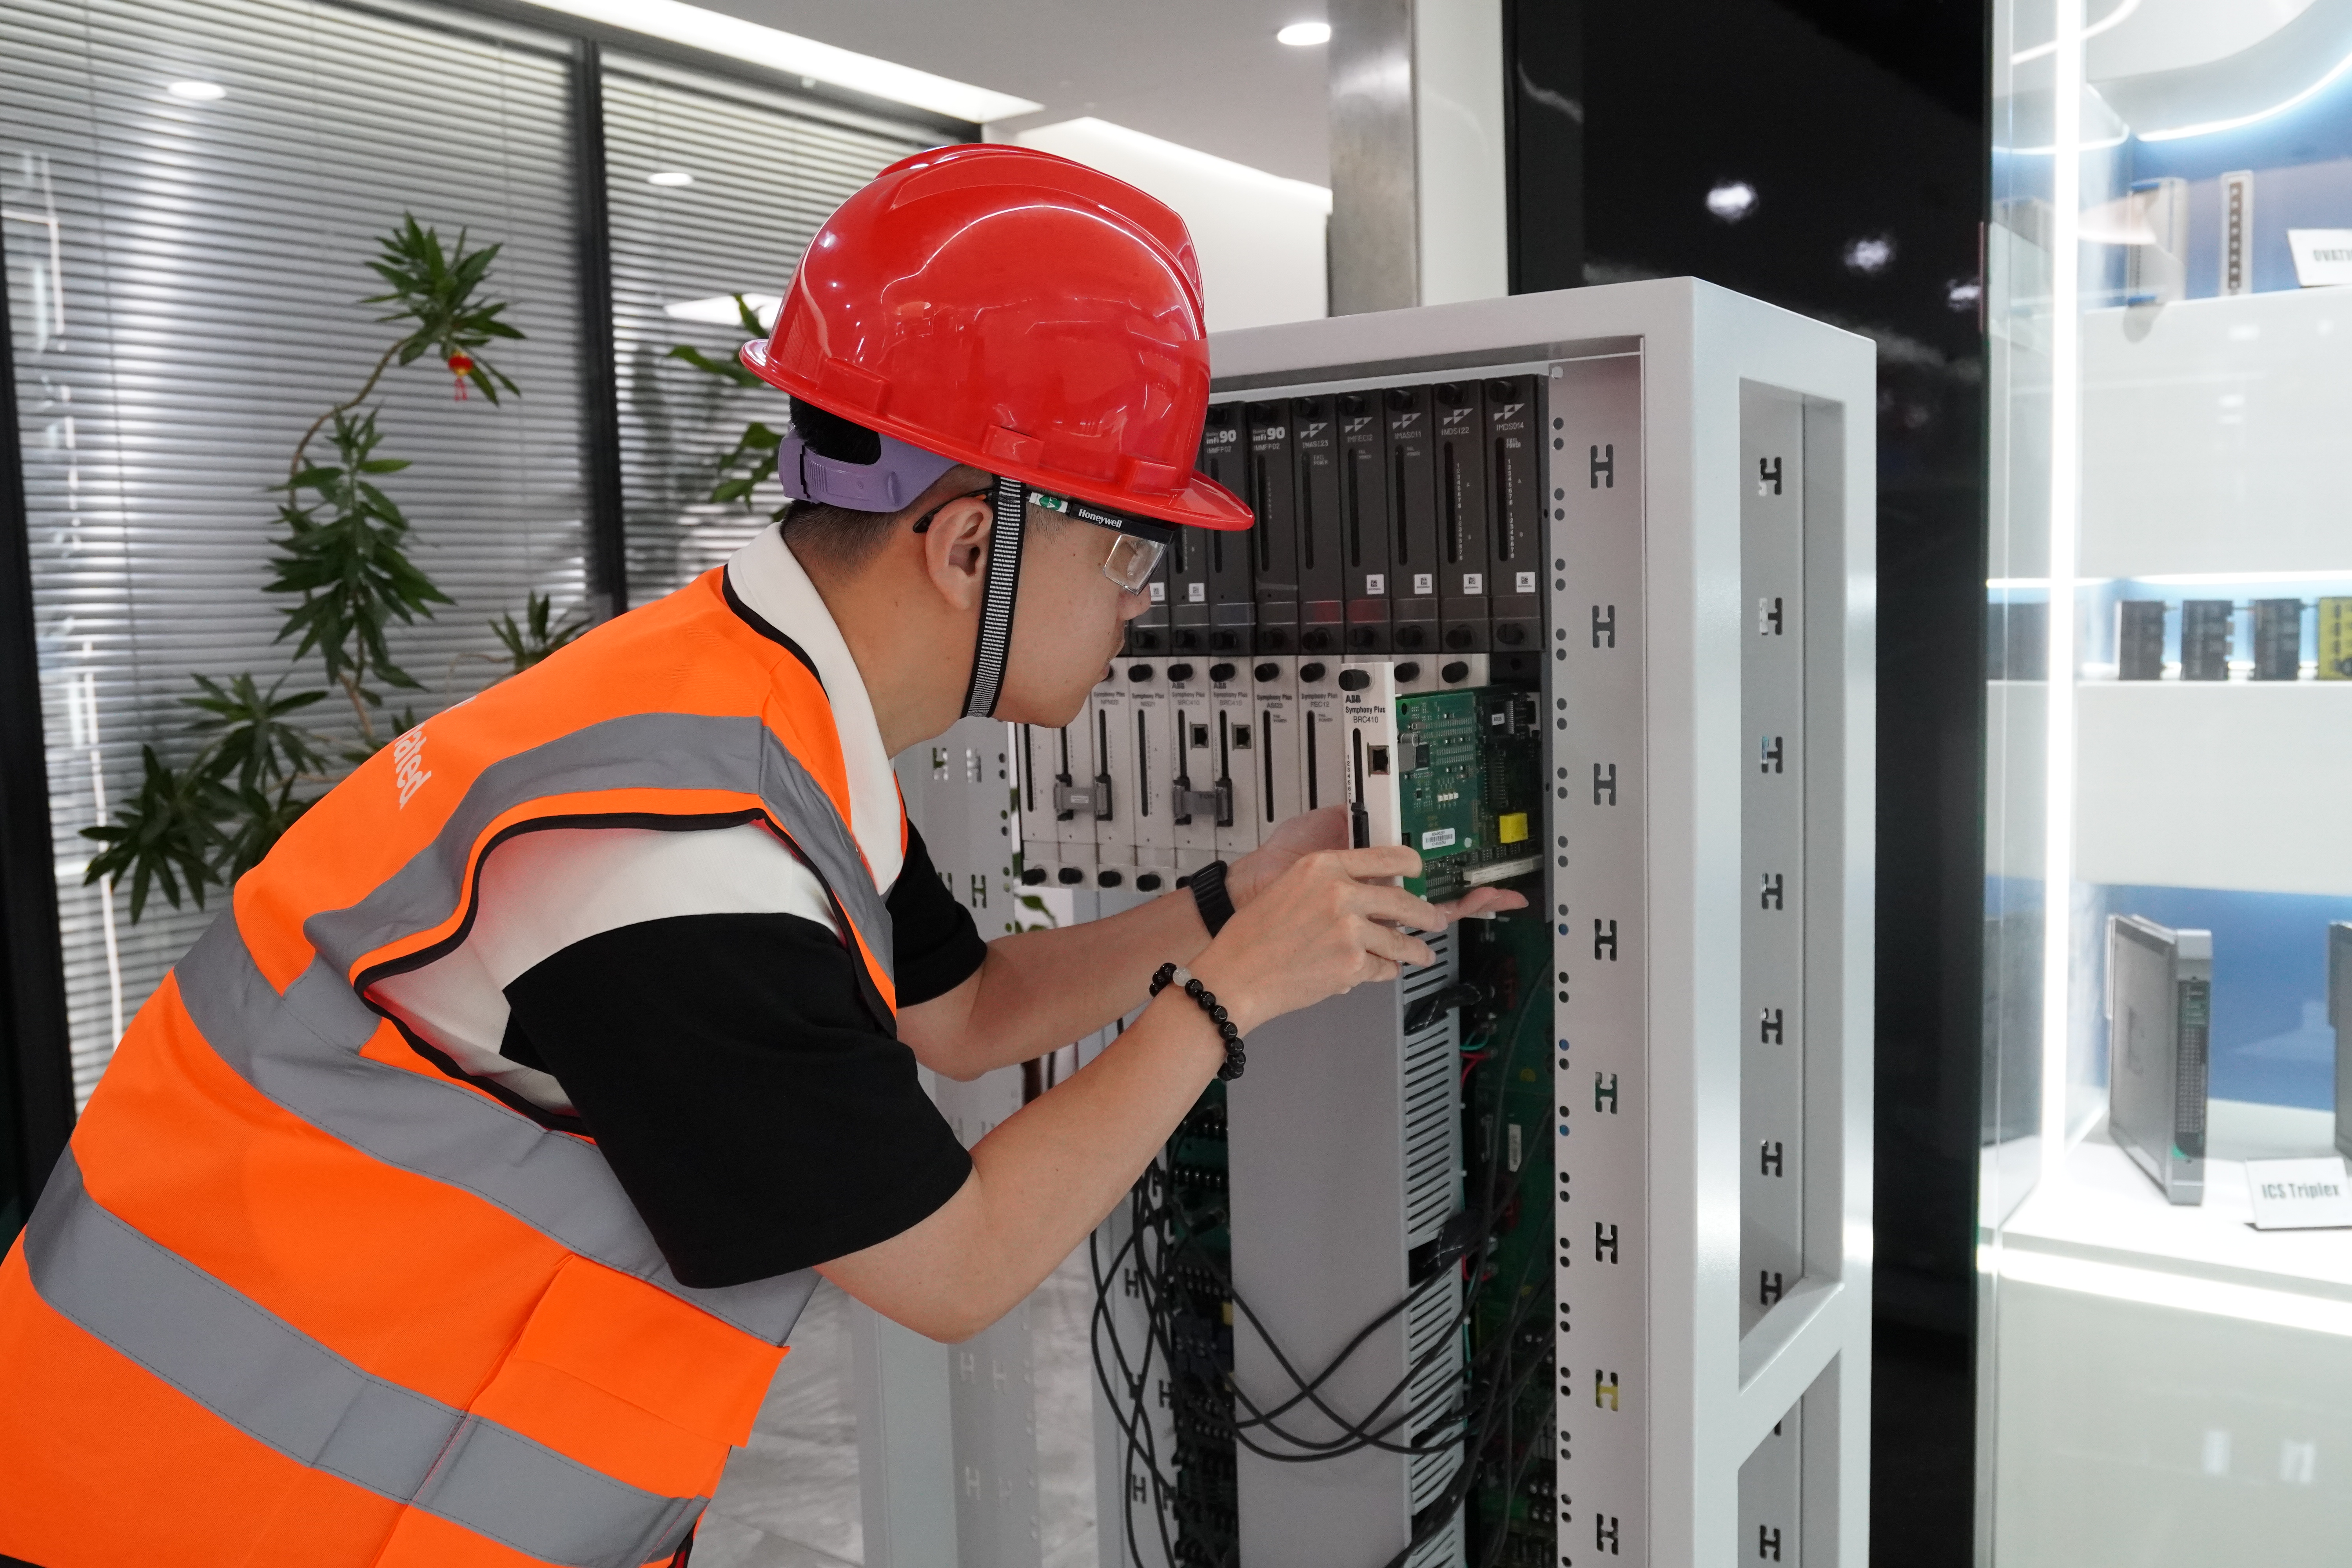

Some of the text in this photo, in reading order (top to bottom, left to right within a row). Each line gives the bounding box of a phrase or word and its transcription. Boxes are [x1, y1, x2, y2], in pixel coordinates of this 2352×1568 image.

[2314, 249, 2352, 261] OVATI
[1078, 508, 1122, 528] Honeywell
[1345, 695, 1361, 703] ABB
[1346, 706, 1372, 715] Symphony
[2261, 1182, 2340, 1199] ICS Triplex
